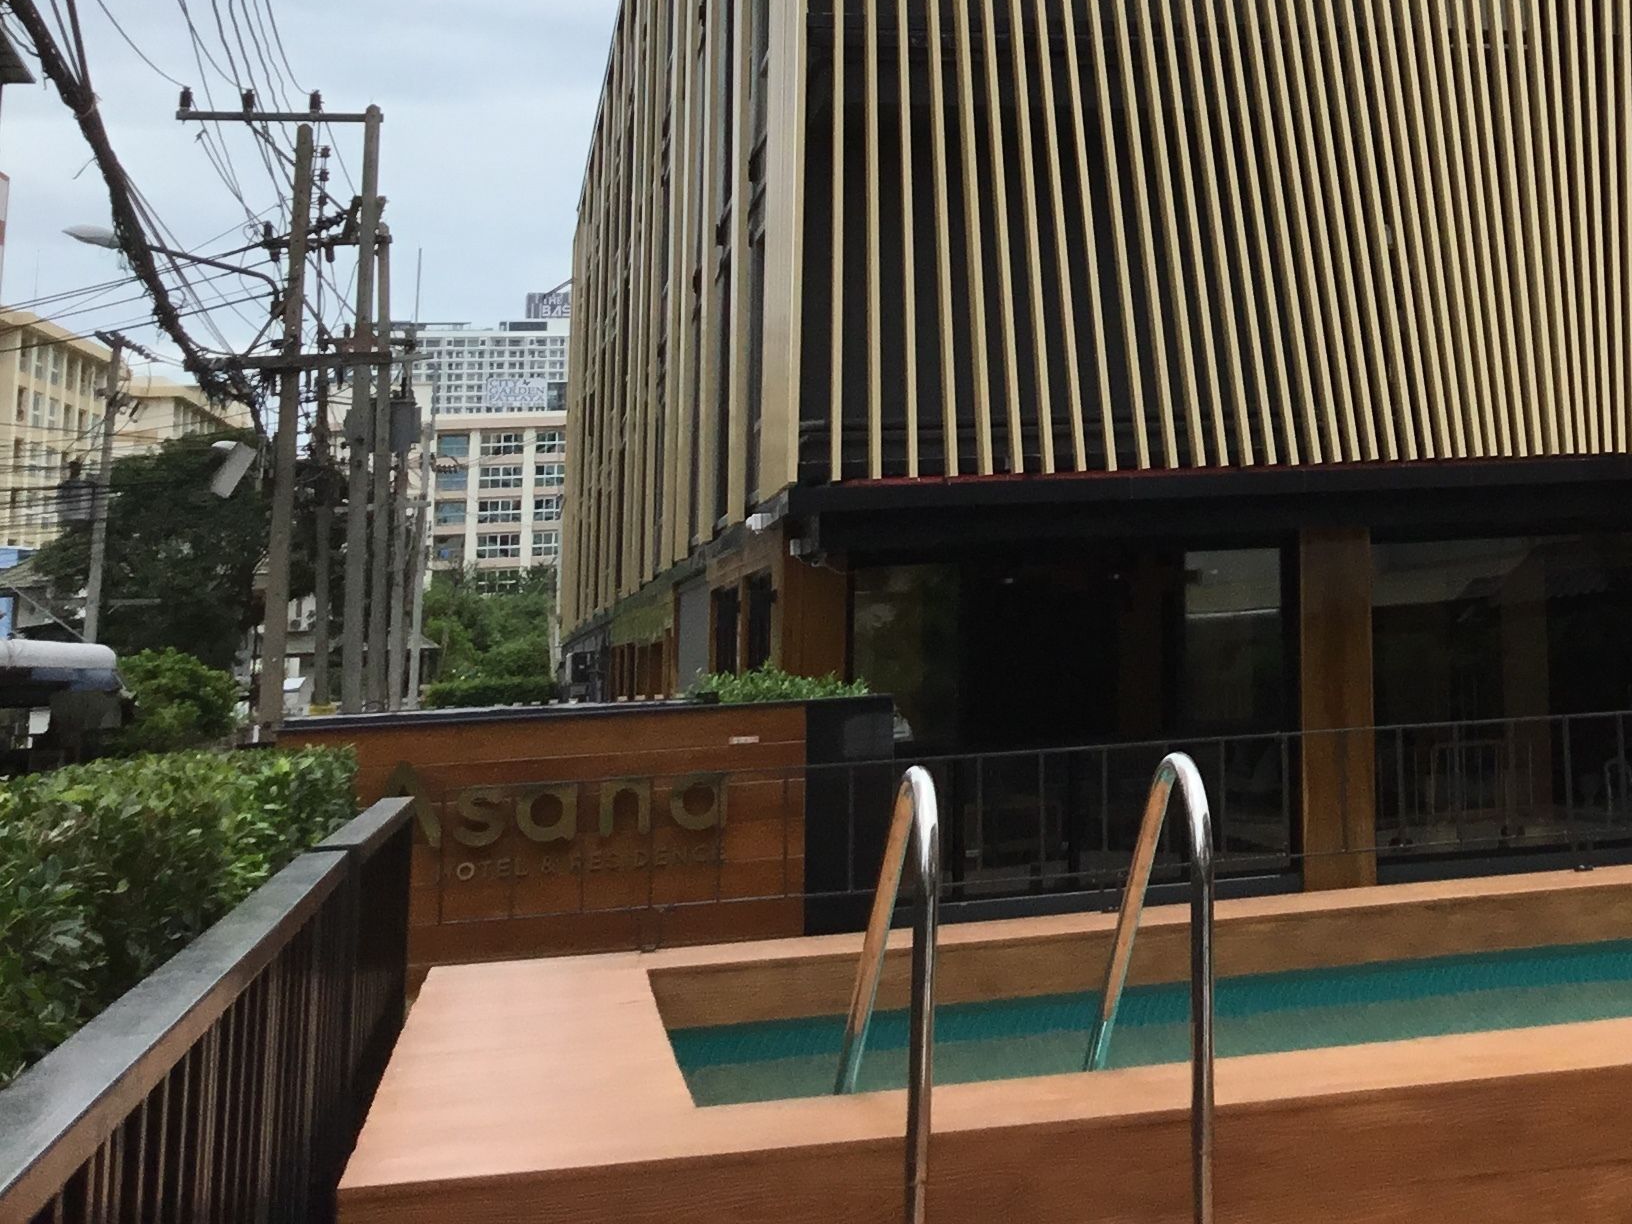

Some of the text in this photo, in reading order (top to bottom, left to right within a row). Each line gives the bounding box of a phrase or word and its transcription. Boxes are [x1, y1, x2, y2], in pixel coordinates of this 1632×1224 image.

[489, 378, 520, 387] CITY
[384, 760, 727, 848] Asana
[438, 857, 529, 881] OTEL
[570, 843, 726, 873] RESDENC
